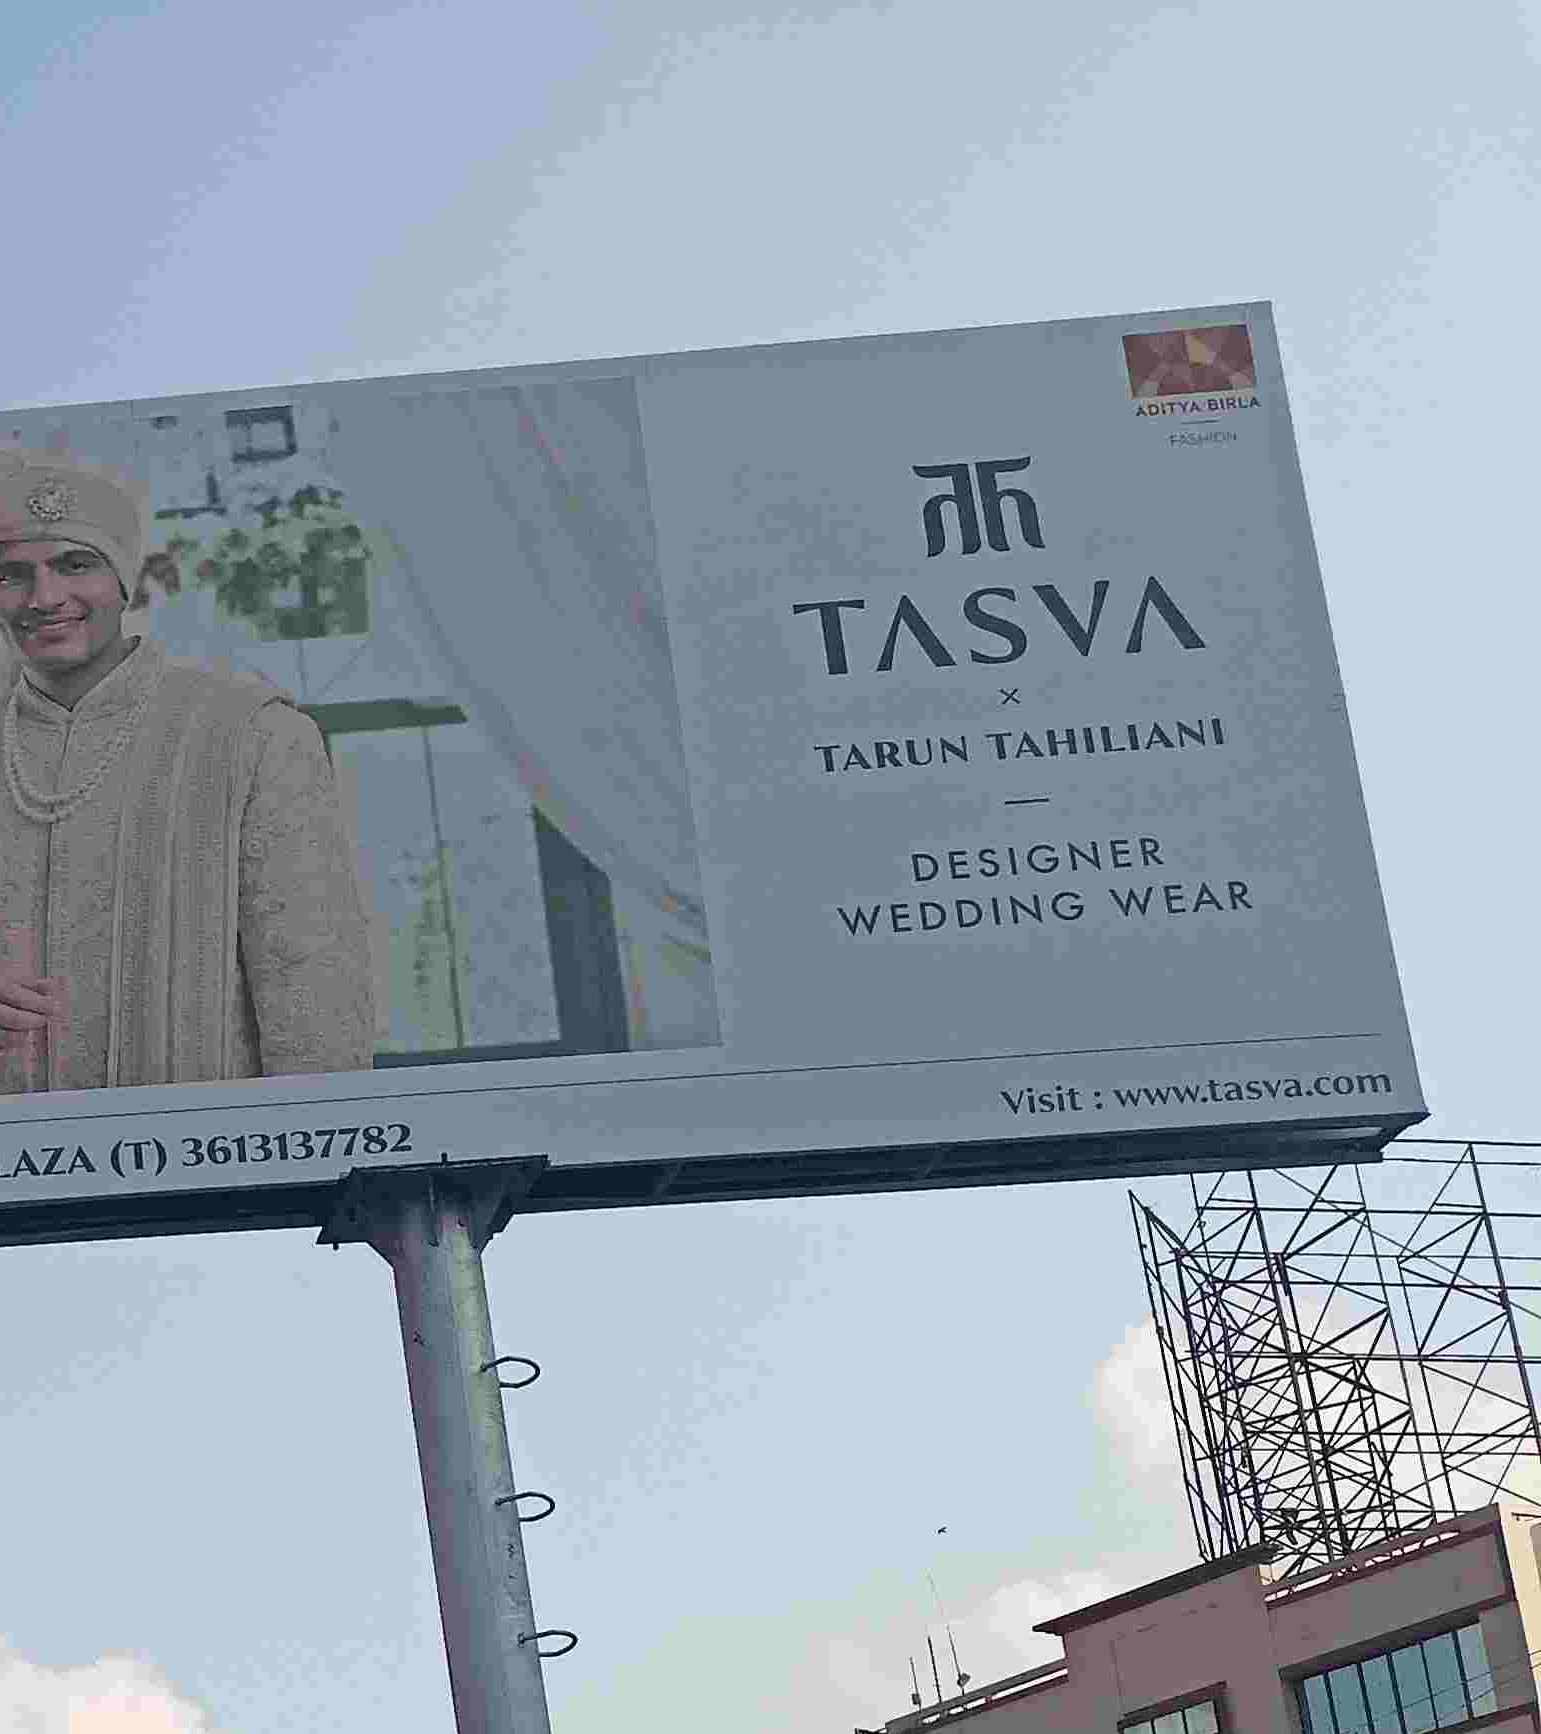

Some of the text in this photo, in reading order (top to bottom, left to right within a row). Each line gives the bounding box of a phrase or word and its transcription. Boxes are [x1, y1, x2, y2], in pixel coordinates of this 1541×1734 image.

[1136, 397, 1261, 416] ADITYA BIRLA
[792, 575, 1207, 676] TASVA
[813, 716, 1226, 775] TARUN TAHILIANI
[910, 836, 1165, 884] DESIGNER
[836, 879, 1255, 937] WEDDING WEAR
[999, 1083, 1084, 1116] Visit
[1114, 1070, 1394, 1108] www.tasva.com
[109, 1137, 168, 1179] (T)
[181, 1122, 413, 1168] 3613137782
